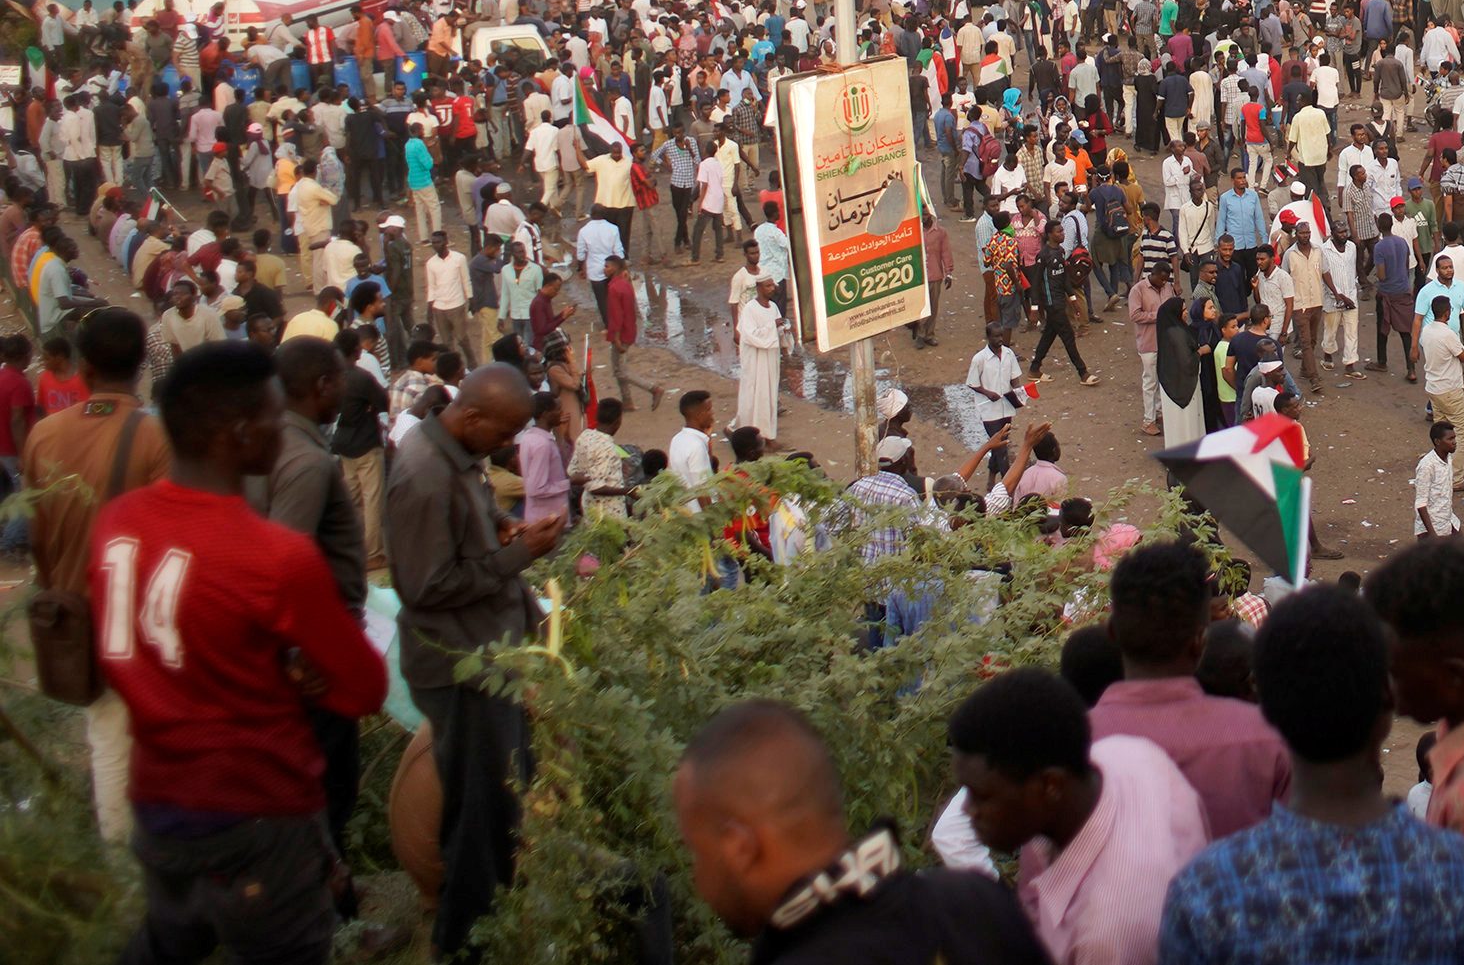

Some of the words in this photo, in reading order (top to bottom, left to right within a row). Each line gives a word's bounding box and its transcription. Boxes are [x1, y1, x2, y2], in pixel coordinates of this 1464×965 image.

[865, 131, 906, 156] شيكان
[816, 162, 856, 182] SHIEK
[858, 148, 907, 170] NSURANCE
[860, 235, 891, 252] الحوادث
[891, 227, 913, 243] تأمين
[828, 245, 860, 262] المتنوعة
[860, 260, 895, 276] Customer
[895, 254, 913, 265] Care
[861, 263, 914, 299] 2220
[101, 536, 193, 669] 14
